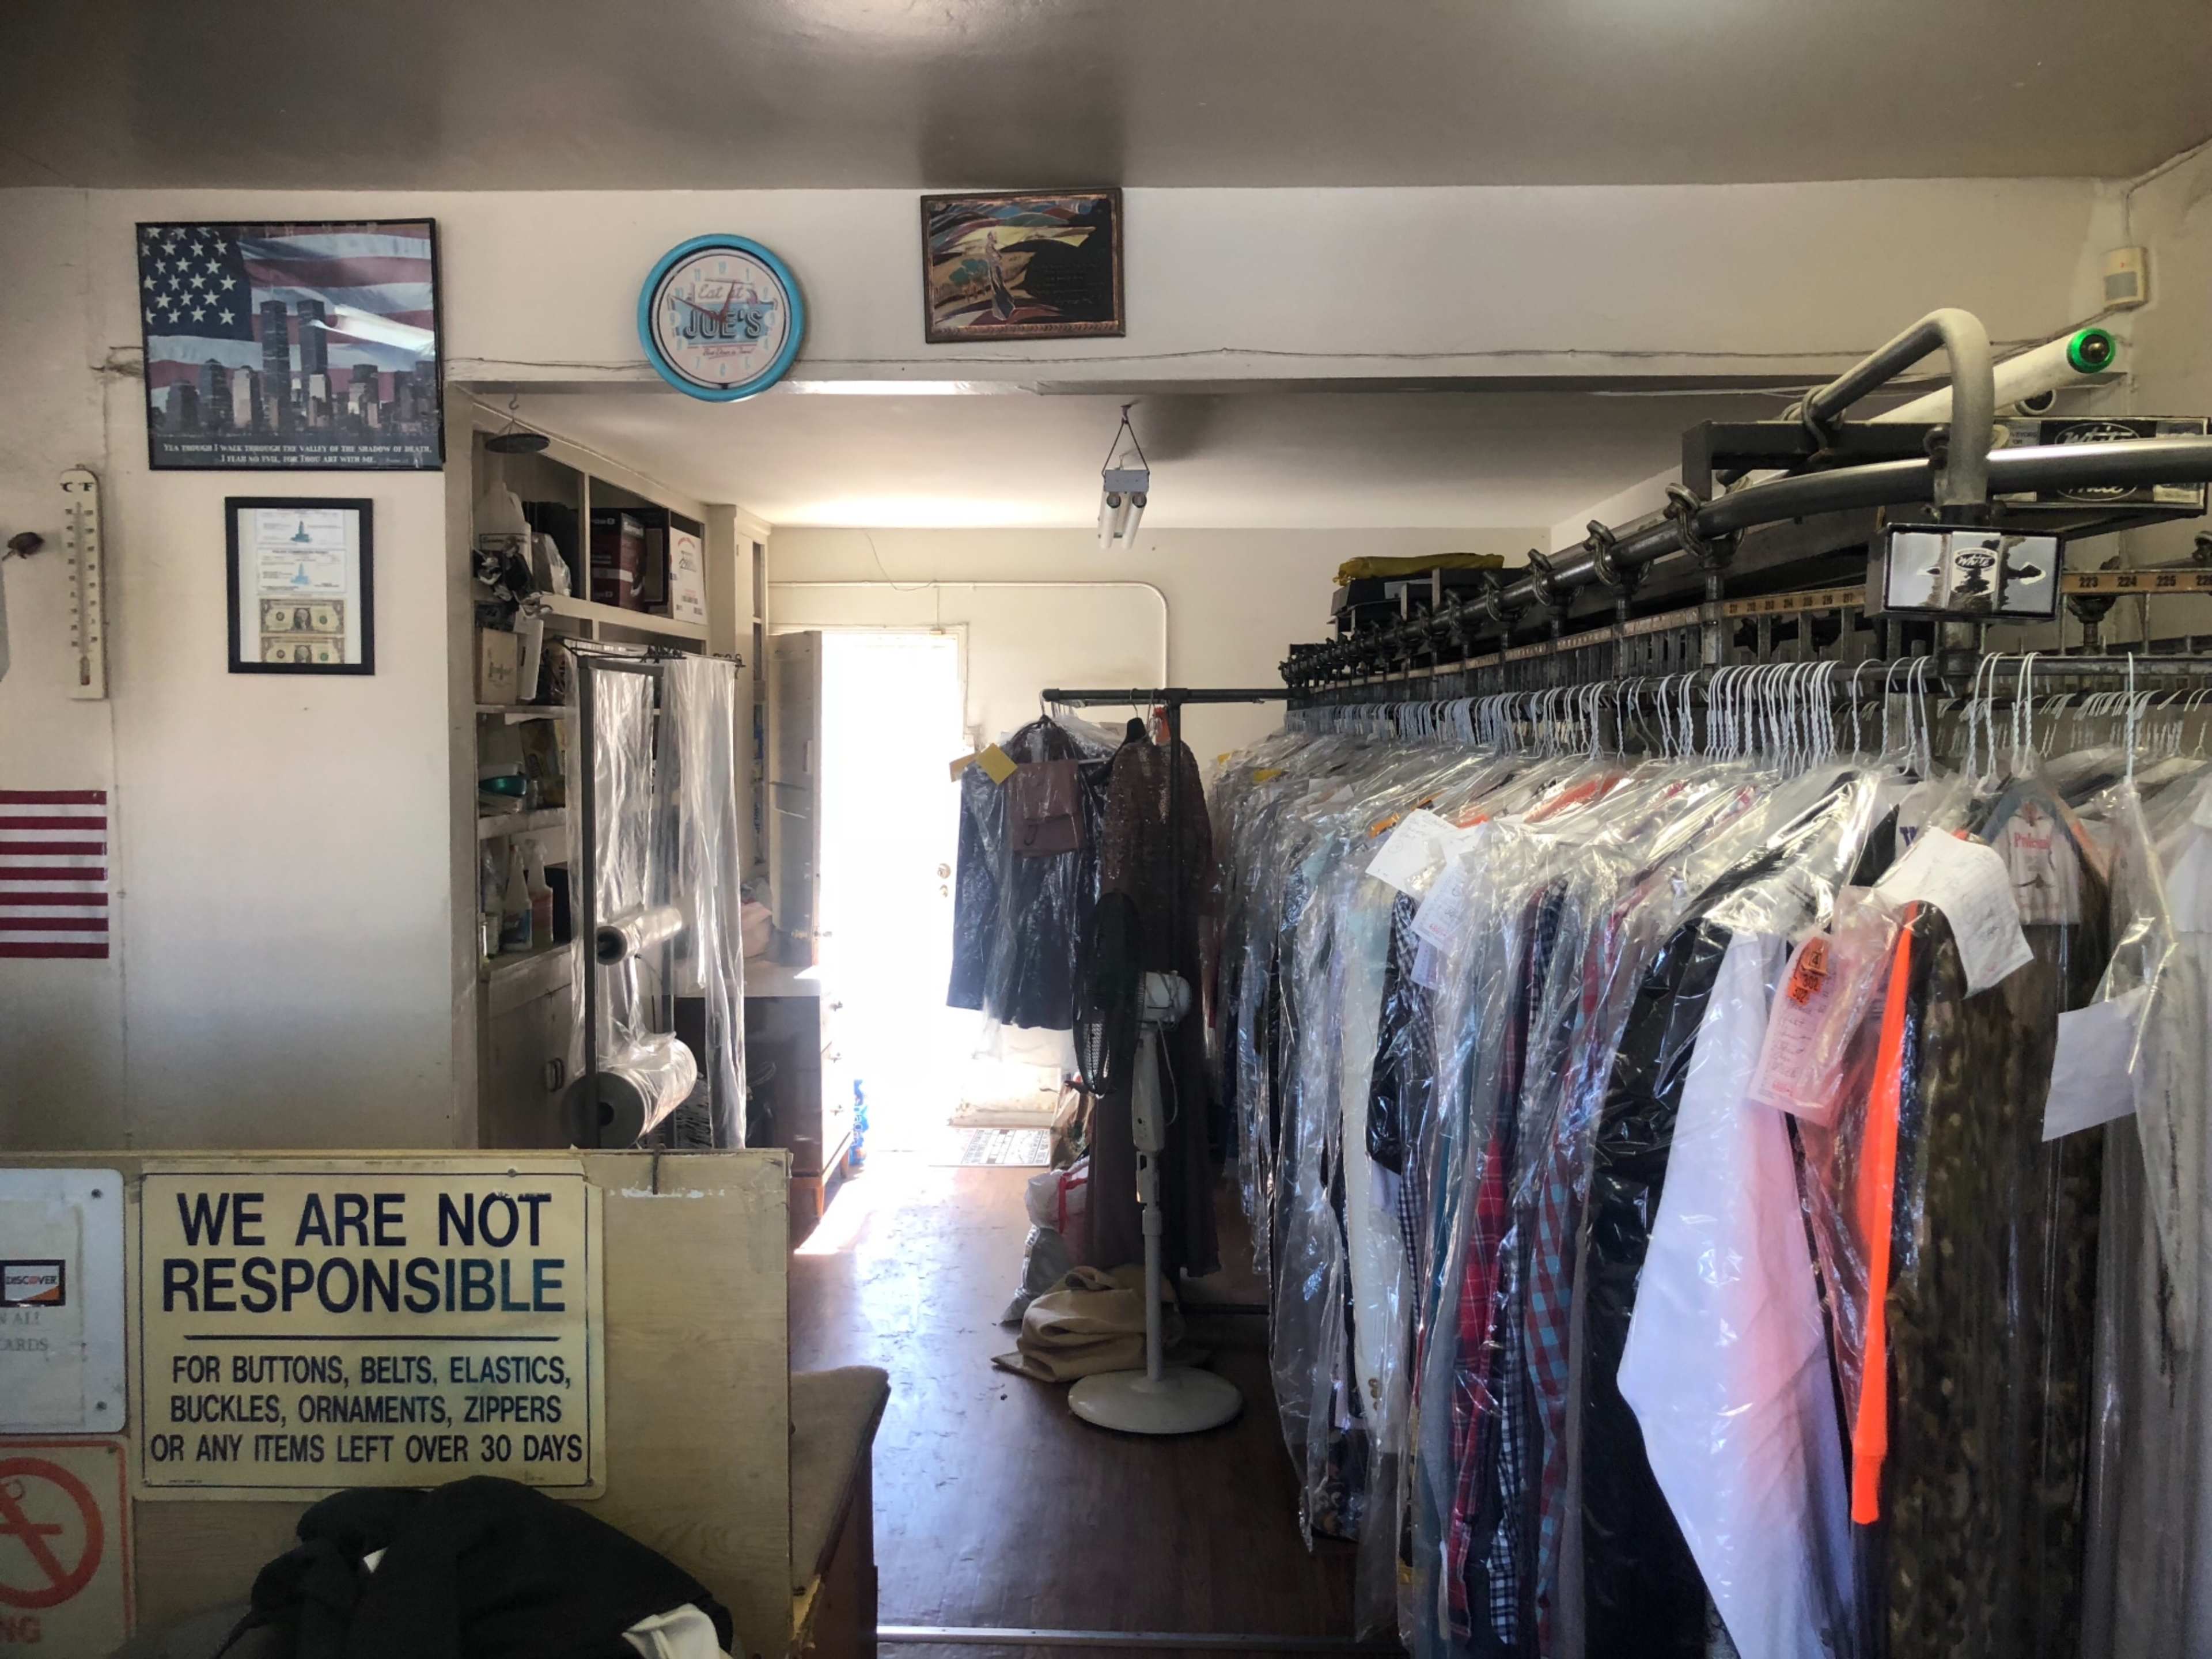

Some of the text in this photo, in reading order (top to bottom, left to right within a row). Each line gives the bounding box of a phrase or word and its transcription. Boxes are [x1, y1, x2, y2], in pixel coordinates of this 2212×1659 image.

[698, 284, 722, 299] Eat
[683, 308, 763, 339] JOE'S
[2078, 577, 2099, 588] 223
[2116, 576, 2137, 588] 224
[2156, 575, 2176, 587] 225
[177, 1192, 552, 1248] WE ARE NOT
[6, 1275, 57, 1285] DISCOVER
[164, 1257, 565, 1314] RESPONSIBLE
[0, 1338, 48, 1351] ARDS
[173, 1355, 220, 1384] FOR
[233, 1355, 349, 1389] BUTTONS,
[450, 1356, 570, 1389] ELASTICS,
[171, 1395, 562, 1428] BUCKLES, ORNAMENTS, ZIPPERS
[151, 1434, 582, 1463] OR ANY ITEMS LEFT OVER 30 DAYS
